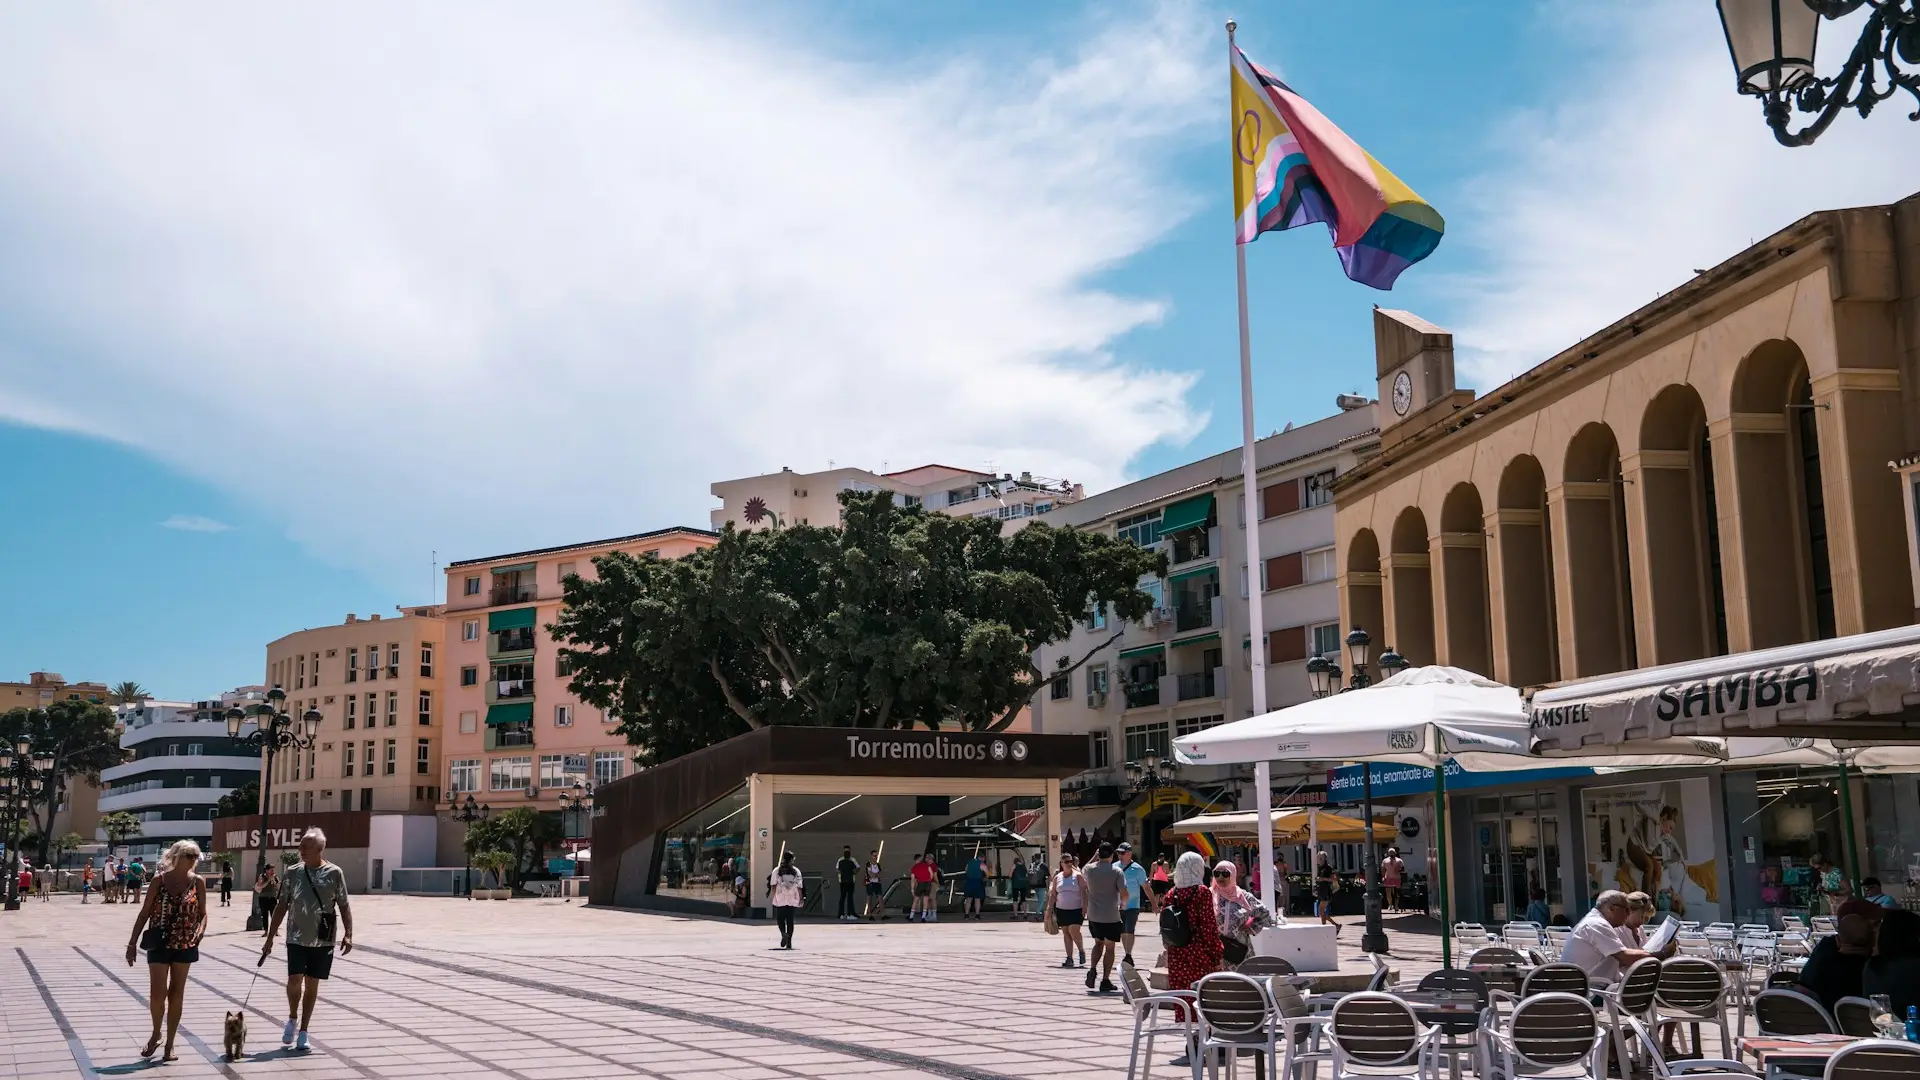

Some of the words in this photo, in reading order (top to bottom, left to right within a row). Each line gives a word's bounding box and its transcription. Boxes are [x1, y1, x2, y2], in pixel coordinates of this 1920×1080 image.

[1656, 661, 1817, 722] SAMBA
[1530, 702, 1589, 729] AMSTEL
[847, 735, 986, 761] Torremolinos
[1391, 734, 1414, 742] PURA
[1331, 777, 1349, 790] siente
[1349, 773, 1356, 787] la
[1356, 770, 1382, 786] caad,
[1383, 767, 1421, 782] enamórate
[1442, 761, 1460, 775] ecio
